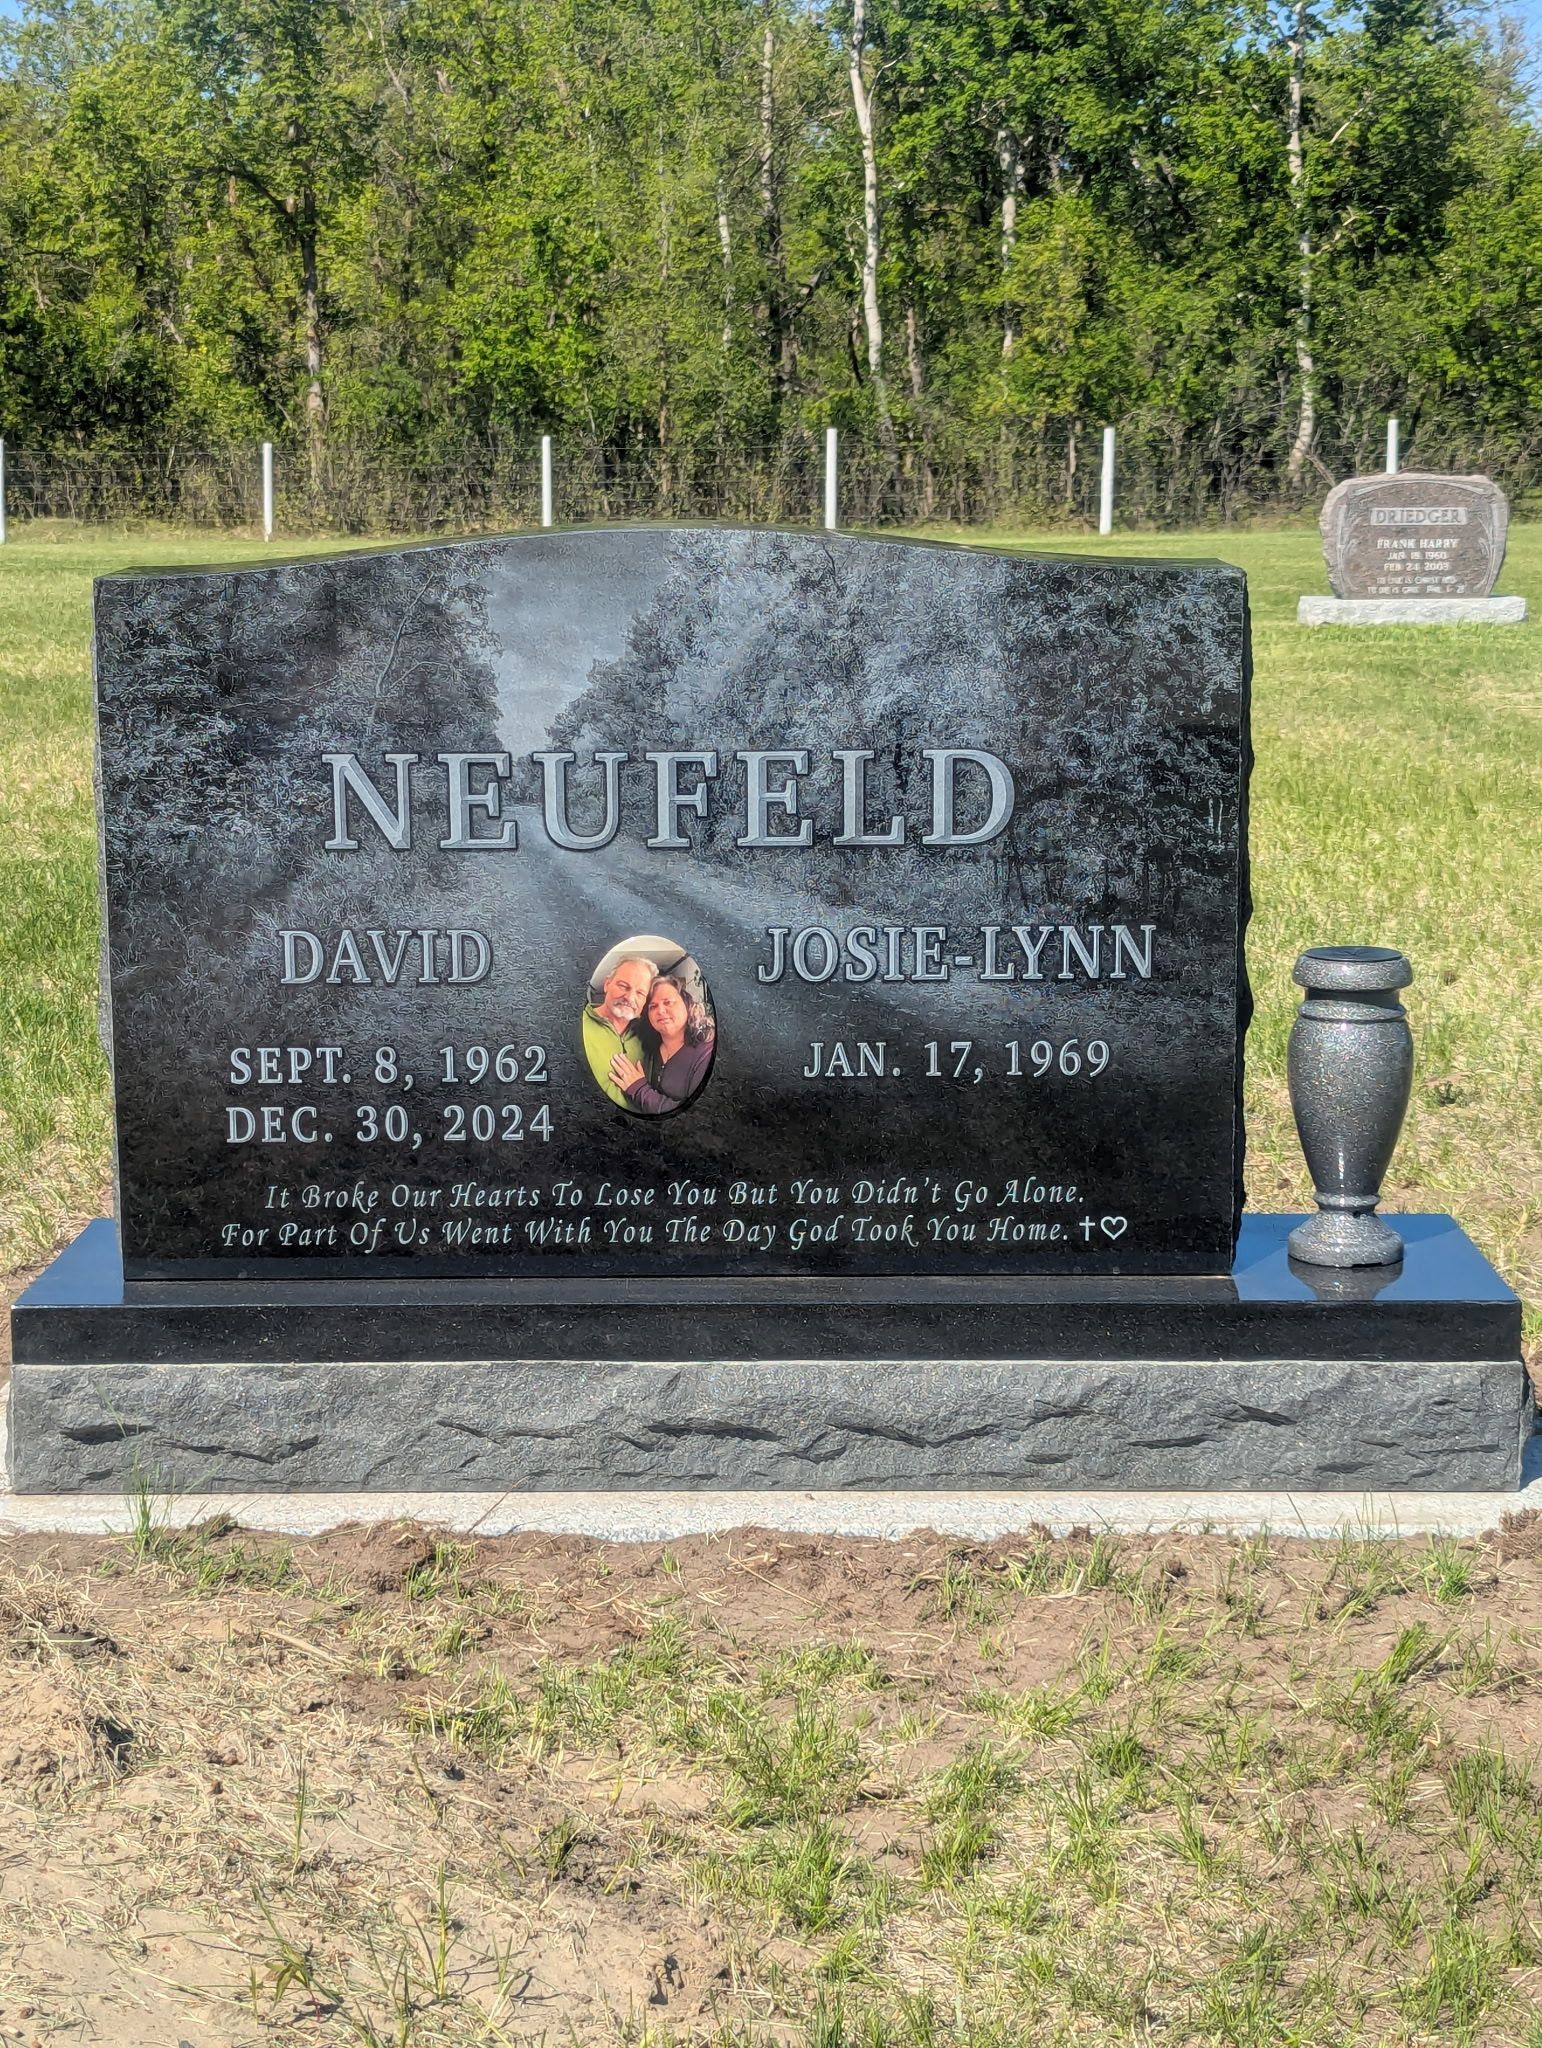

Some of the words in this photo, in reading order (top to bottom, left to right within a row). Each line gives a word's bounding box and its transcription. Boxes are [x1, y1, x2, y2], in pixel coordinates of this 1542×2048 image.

[1375, 509, 1461, 523] DRIEDGER
[1377, 539, 1416, 548] FRANK
[1420, 539, 1459, 548] HARRY
[321, 749, 1016, 850] NEUFELD
[279, 929, 492, 985] DAVID
[757, 924, 1156, 982] JOSIE-LYNN
[230, 1047, 351, 1084] SEPT.
[374, 1046, 414, 1090] 8,
[440, 1045, 548, 1083] 1962
[804, 1042, 901, 1078] JAN.
[924, 1041, 984, 1083] 17,
[1006, 1039, 1110, 1077] 1969
[226, 1106, 334, 1143] DEC.
[356, 1106, 423, 1150] 30,
[444, 1104, 554, 1142] 2024
[265, 1185, 291, 1209] It
[302, 1181, 379, 1214] Broke
[391, 1184, 441, 1208] Our
[449, 1182, 540, 1207] Hearts
[552, 1182, 583, 1207] To
[594, 1182, 655, 1206] Lose
[668, 1180, 717, 1206] You
[729, 1180, 778, 1204] But
[790, 1179, 840, 1204] You
[851, 1177, 942, 1204] Didn't
[955, 1179, 989, 1212] Go
[997, 1177, 1085, 1206] Alone.
[222, 1222, 270, 1247] For
[279, 1222, 338, 1246] Part
[351, 1219, 385, 1253] Of
[395, 1220, 430, 1246] Us
[441, 1219, 512, 1245] Went
[525, 1217, 591, 1244] With
[603, 1218, 654, 1243] You
[665, 1216, 711, 1243] The
[723, 1219, 777, 1250] Day
[789, 1215, 843, 1251] God
[851, 1217, 919, 1246] Took
[926, 1216, 977, 1242] You
[986, 1216, 1068, 1242] Home.
